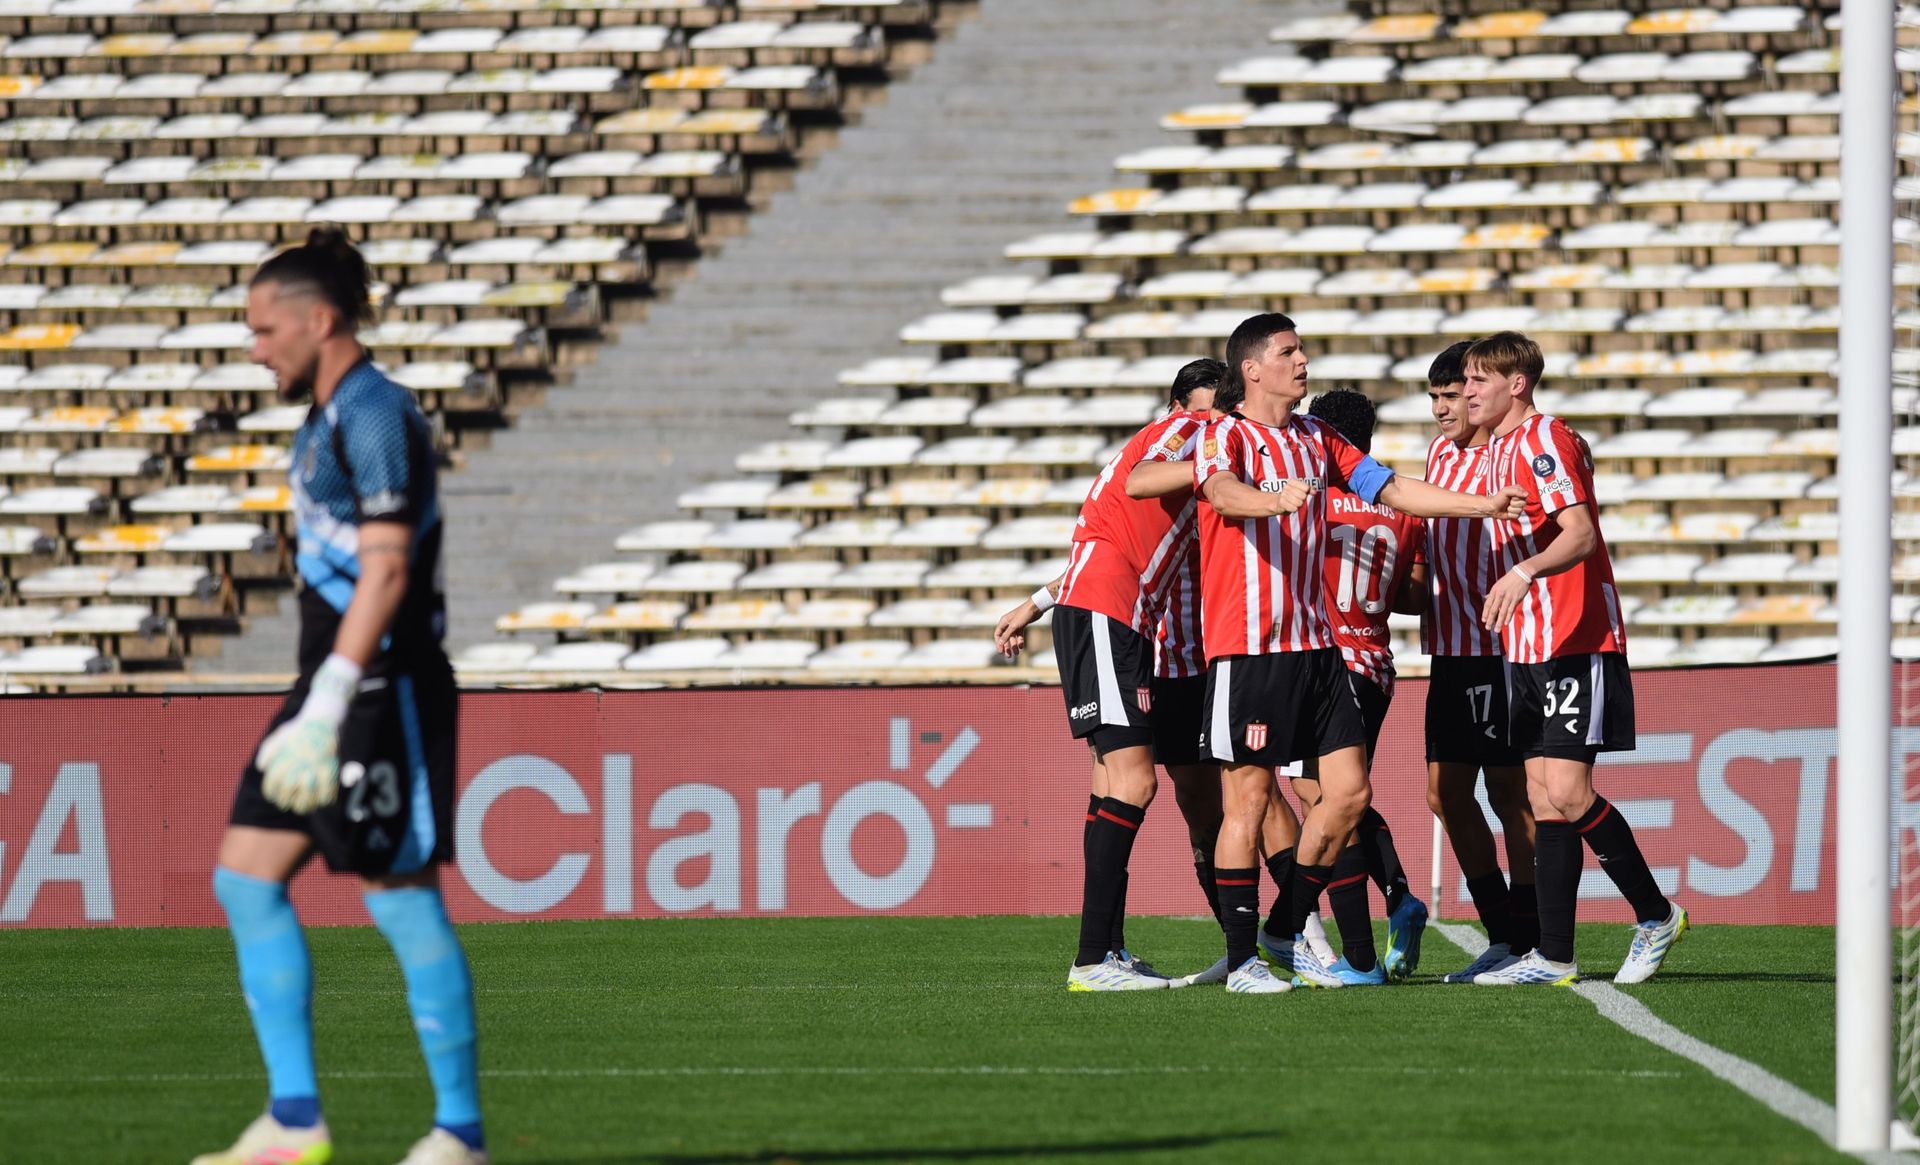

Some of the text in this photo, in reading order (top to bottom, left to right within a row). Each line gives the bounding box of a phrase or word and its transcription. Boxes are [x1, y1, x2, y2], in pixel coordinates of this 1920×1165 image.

[1331, 524, 1398, 614] 10
[1465, 684, 1493, 723] 17
[1544, 677, 1580, 717] 32
[0, 762, 116, 922] A
[455, 754, 936, 913] Claro
